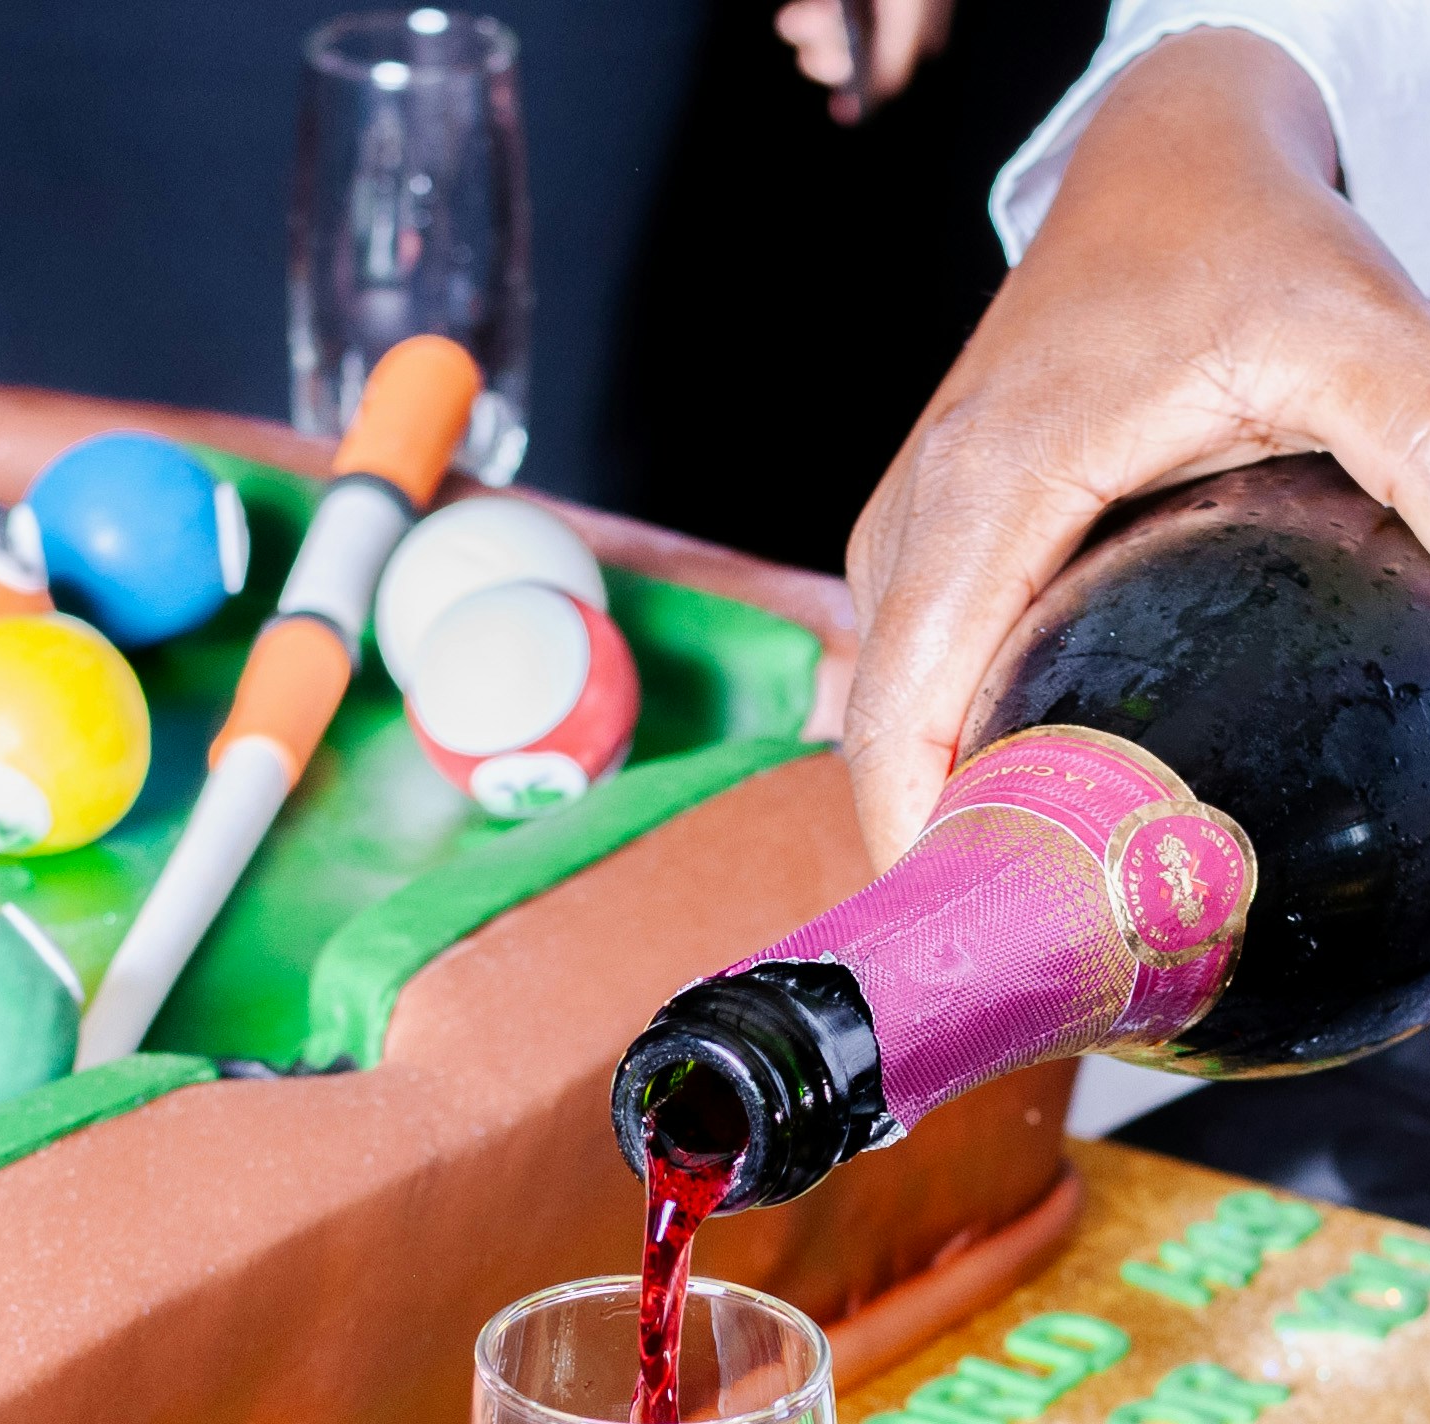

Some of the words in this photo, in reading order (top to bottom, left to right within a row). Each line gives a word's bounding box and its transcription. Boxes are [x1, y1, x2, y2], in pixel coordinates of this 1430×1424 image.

[1065, 771, 1097, 792] LA
[1199, 824, 1234, 858] ROUX
[1120, 1190, 1323, 1307] HAS
